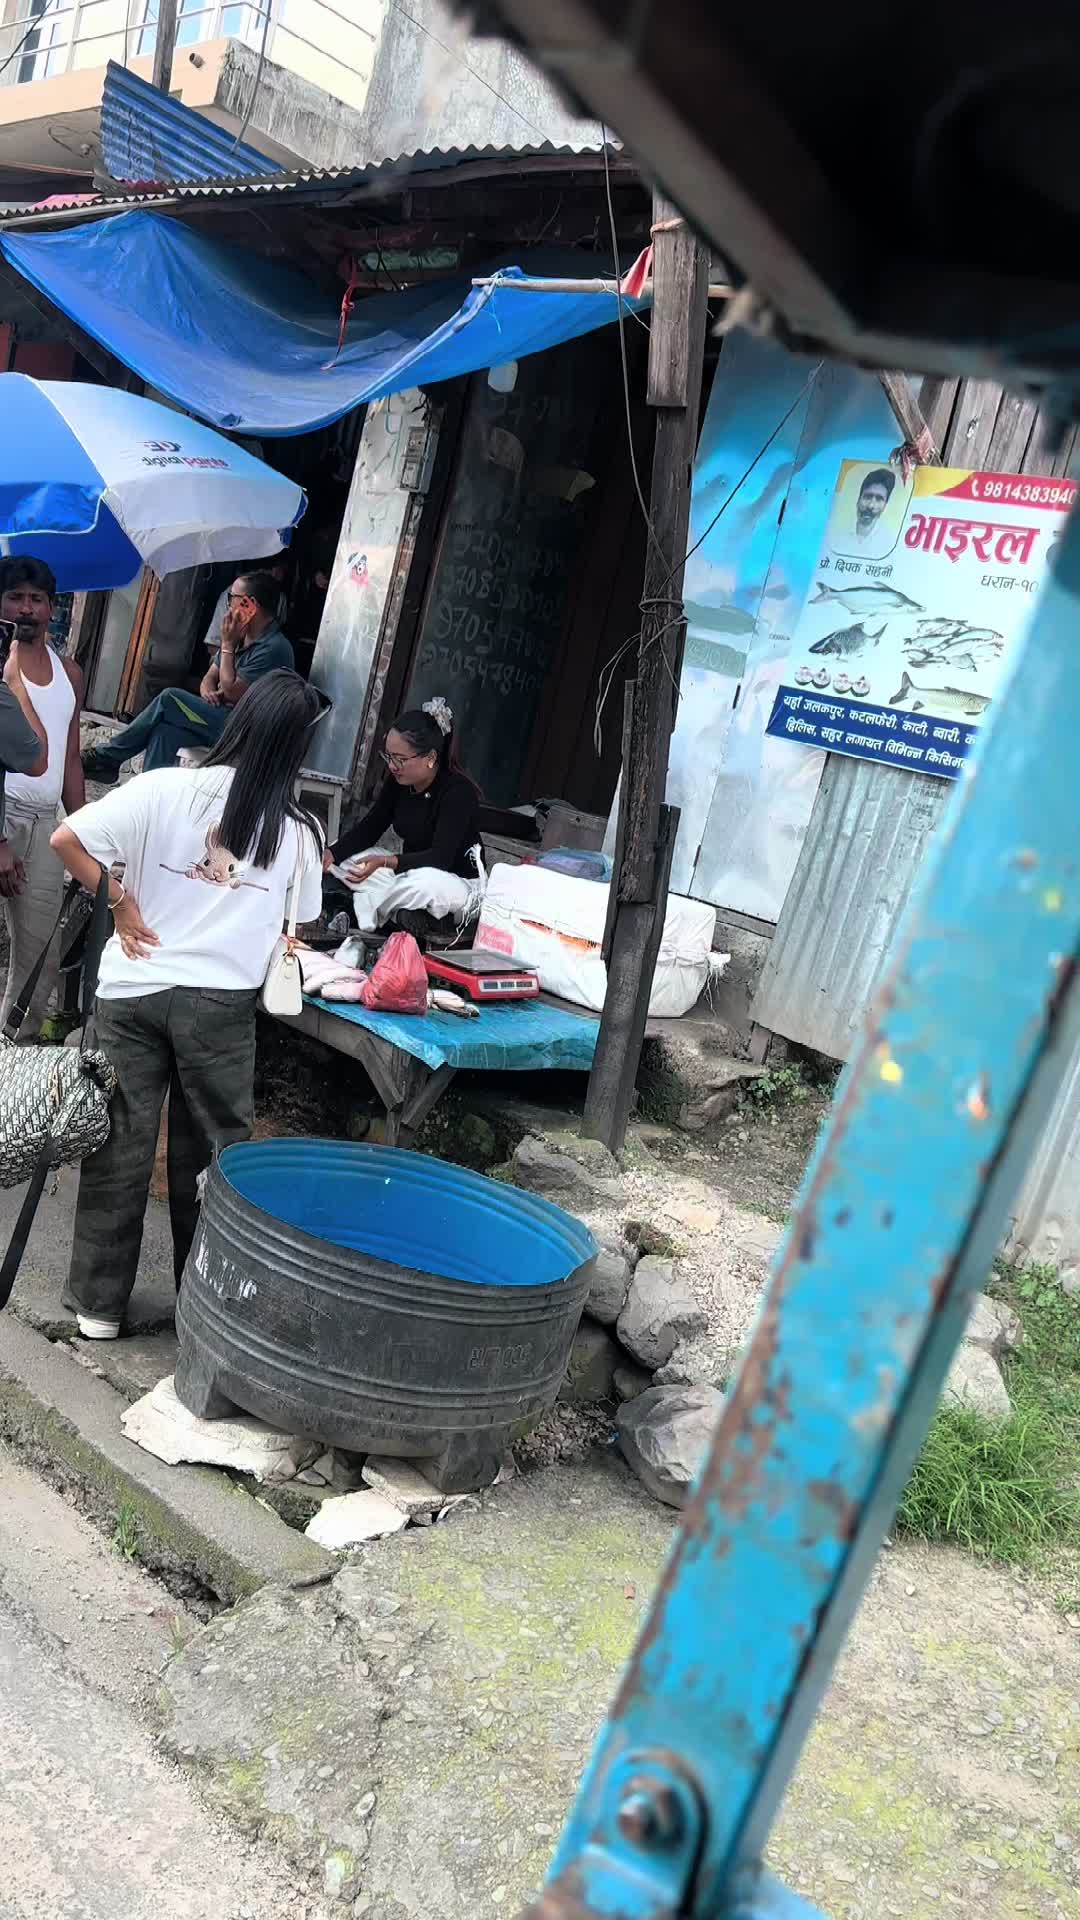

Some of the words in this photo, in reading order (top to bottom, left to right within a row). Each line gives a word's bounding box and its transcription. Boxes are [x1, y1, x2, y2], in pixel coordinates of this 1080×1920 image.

[142, 456, 184, 468] digital
[904, 513, 1040, 565] भाइरल
[834, 559, 863, 574] दिपक
[865, 564, 894, 578] सहनी
[845, 732, 883, 752] लगायत
[885, 740, 925, 760] विभिन्न
